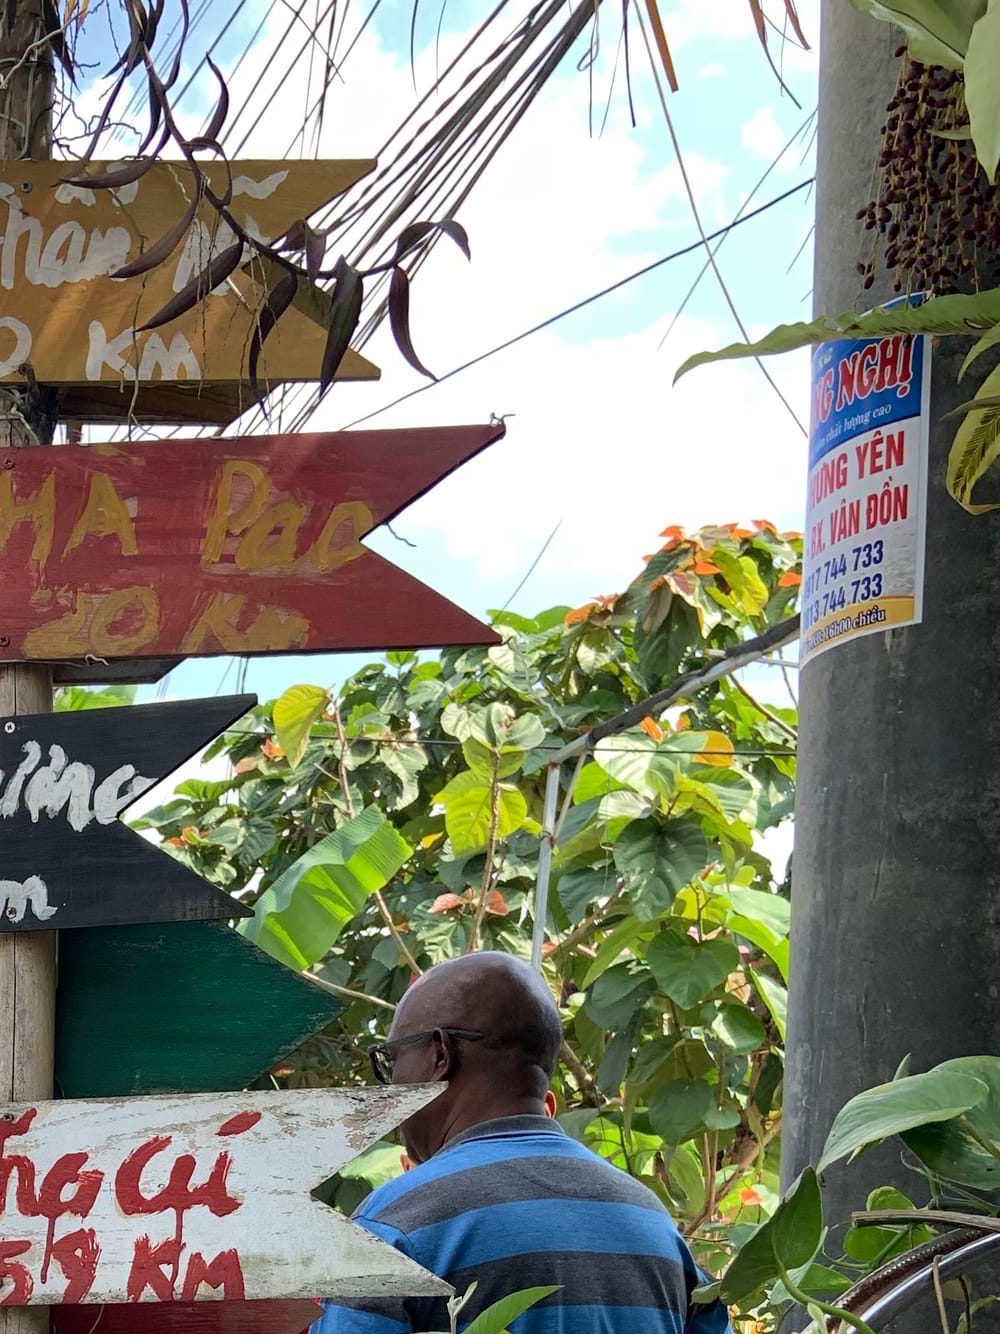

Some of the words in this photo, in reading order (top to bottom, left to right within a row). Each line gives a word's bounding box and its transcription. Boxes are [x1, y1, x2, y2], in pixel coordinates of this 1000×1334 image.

[872, 404, 892, 418] cao
[856, 430, 905, 480] YÊN
[202, 459, 374, 573] Pao
[830, 498, 860, 546] VÂN
[866, 475, 908, 530] ĐỒN
[824, 553, 847, 585] 744
[852, 540, 884, 572] 733
[822, 586, 846, 617] 744
[851, 573, 883, 604] 733
[852, 605, 887, 630] chiều
[22, 584, 160, 659] 20
